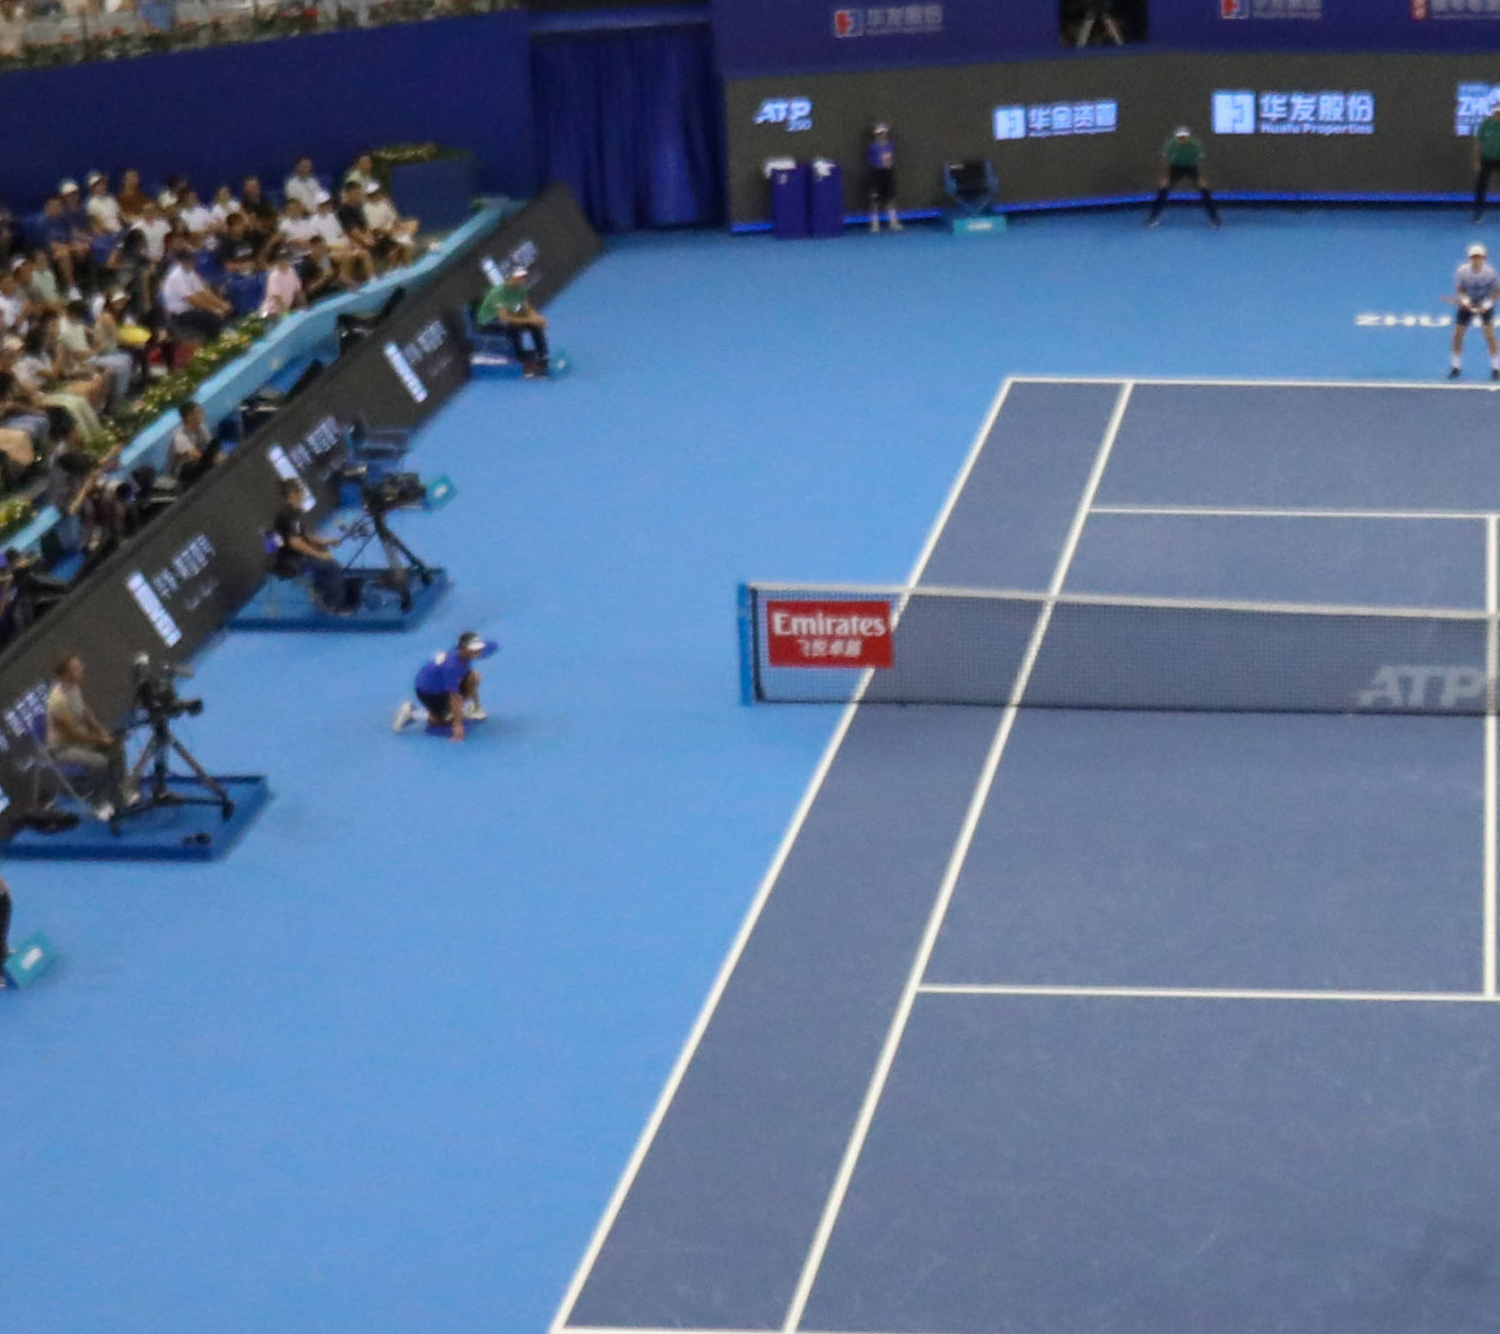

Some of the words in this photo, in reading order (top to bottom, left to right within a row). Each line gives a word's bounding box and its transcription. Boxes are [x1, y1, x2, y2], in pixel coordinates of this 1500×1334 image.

[753, 98, 813, 124] ATP
[1260, 92, 1375, 123] 华发股份
[773, 612, 887, 637] Emirates
[1357, 665, 1489, 708] ATP
